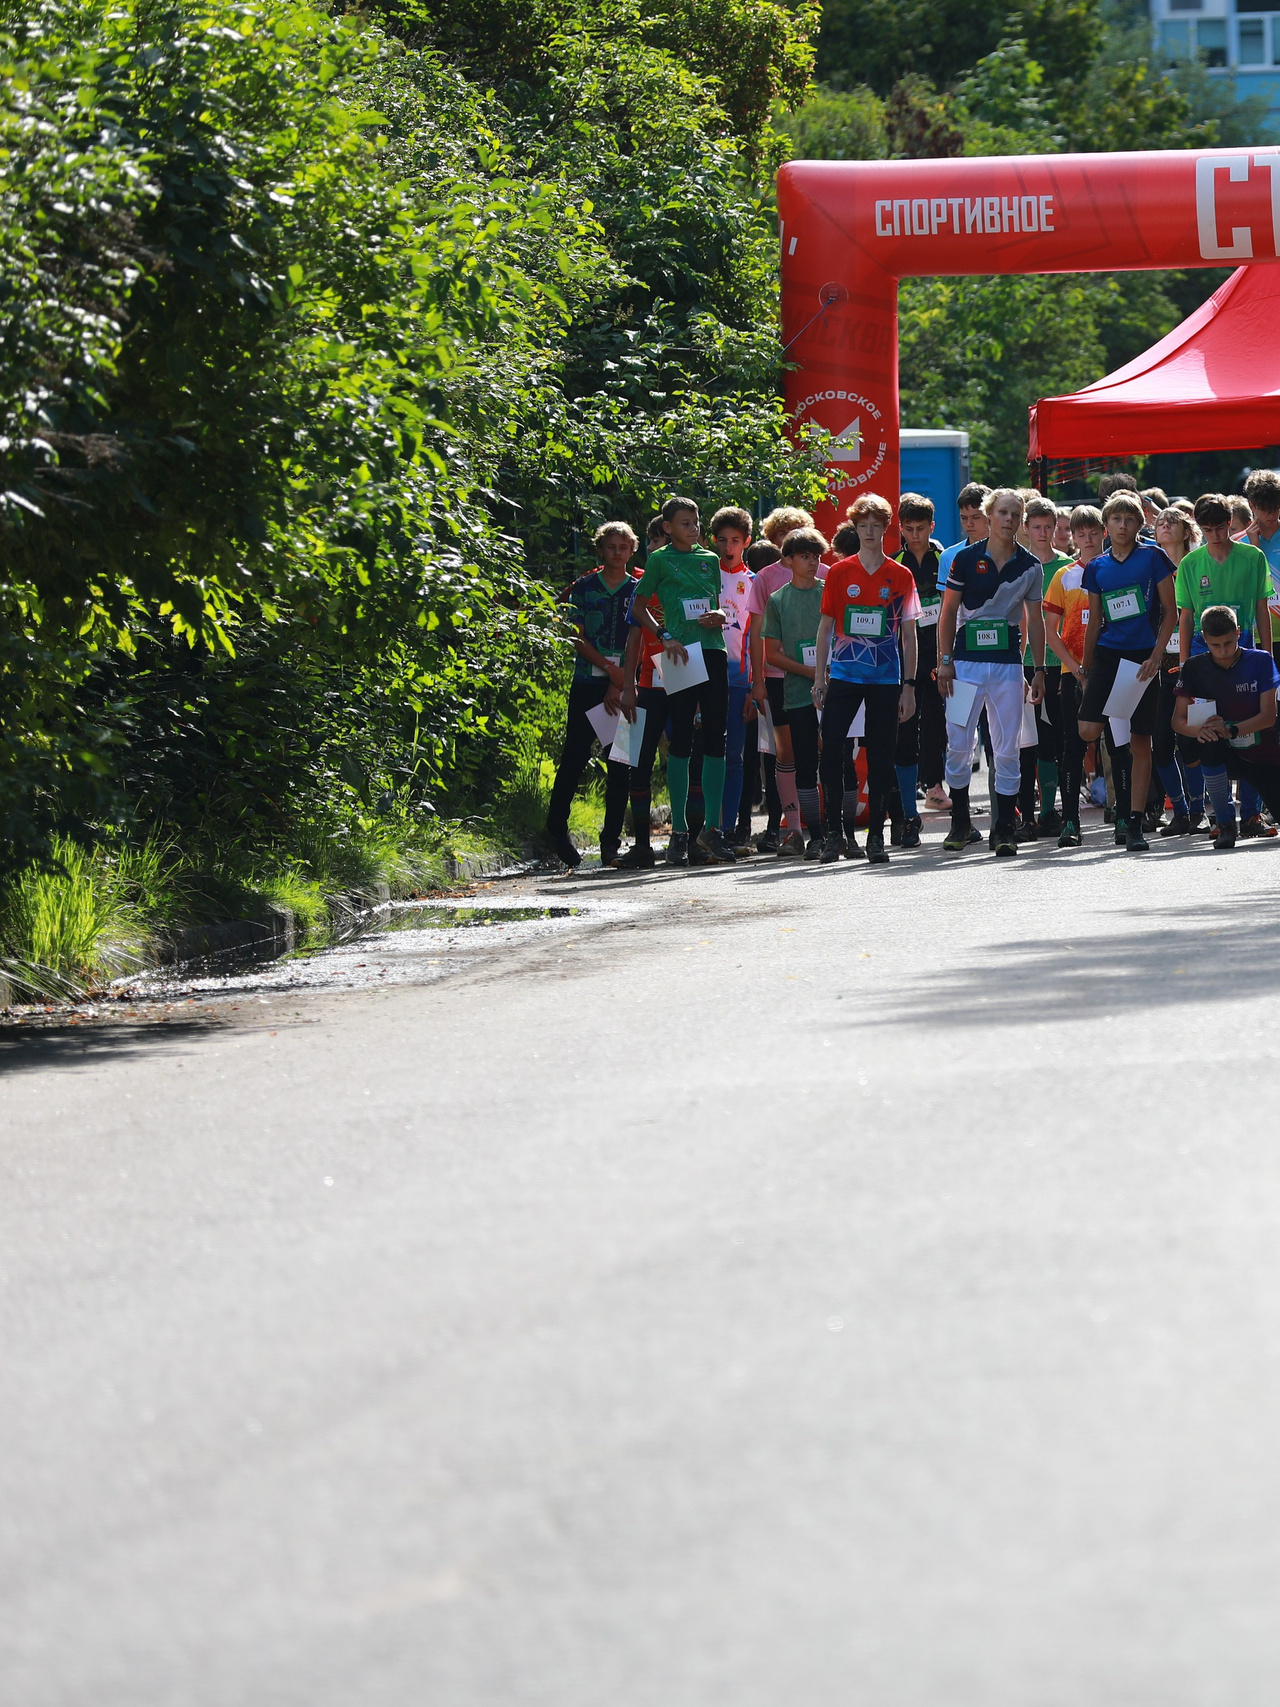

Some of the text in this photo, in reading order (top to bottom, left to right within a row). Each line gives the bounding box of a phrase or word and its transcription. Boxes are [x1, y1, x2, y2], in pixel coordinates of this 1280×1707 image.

[876, 195, 1055, 236] СПОРТИВНОЕ
[793, 390, 882, 421] МОСКОВСКОЕ
[1112, 600, 1131, 610] 107.1
[856, 617, 875, 625] 109.1
